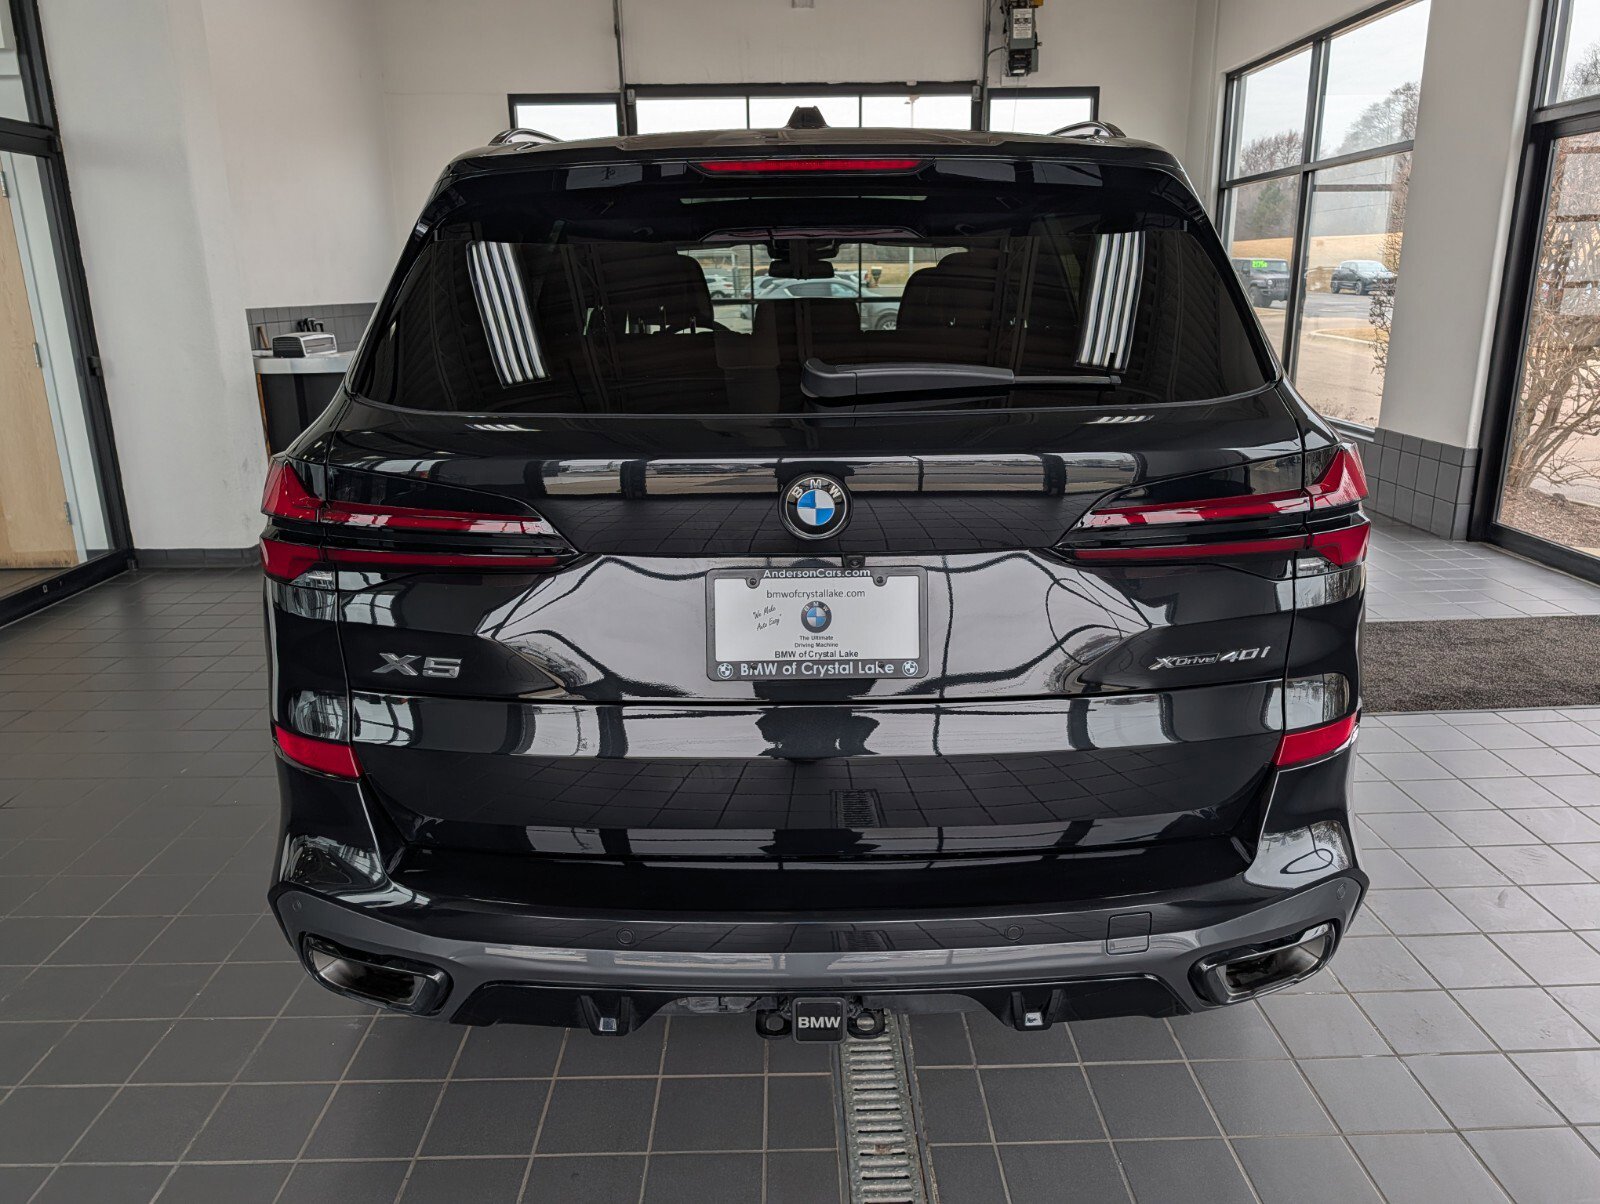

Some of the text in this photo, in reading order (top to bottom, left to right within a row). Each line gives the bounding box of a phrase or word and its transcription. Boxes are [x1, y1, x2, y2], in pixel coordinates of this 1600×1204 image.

[791, 479, 841, 499] BMW
[763, 568, 871, 578] AndersonCars.com
[766, 589, 866, 600] bmwofcrystallake.com
[774, 649, 859, 659] BMW of Crystal Lake
[371, 652, 463, 679] X5
[740, 661, 895, 677] BMW of Crystal Lake
[797, 1016, 841, 1029] BMW
